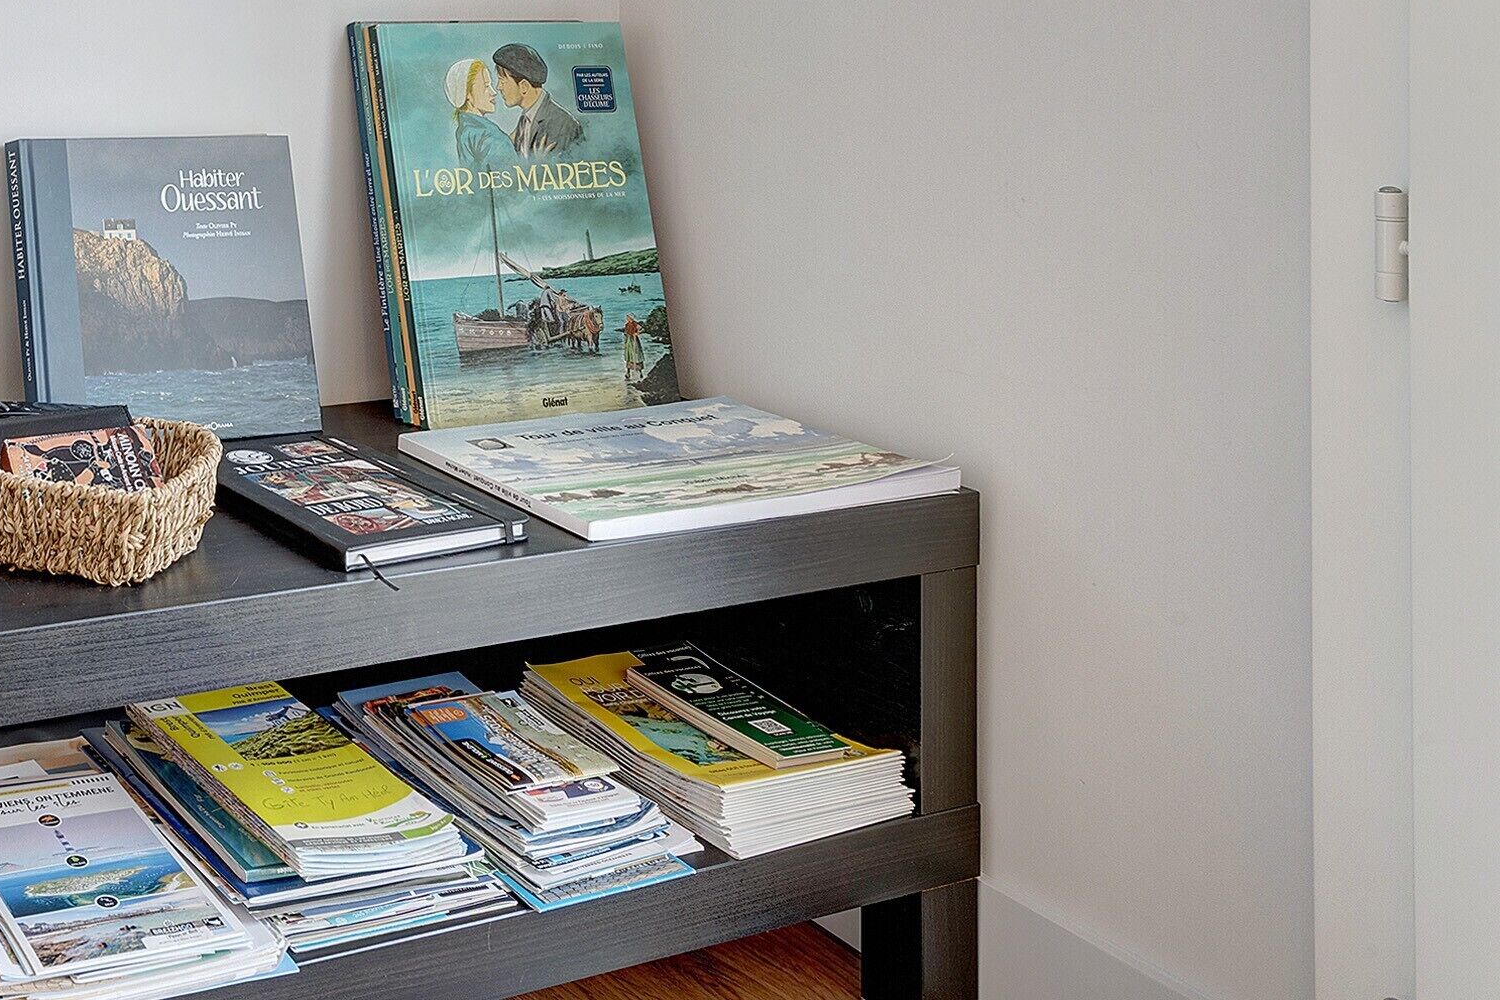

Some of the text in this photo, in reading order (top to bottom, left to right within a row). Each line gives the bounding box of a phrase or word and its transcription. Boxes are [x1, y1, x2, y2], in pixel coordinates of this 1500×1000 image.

[578, 93, 613, 101] CHASSEURS
[178, 168, 246, 189] Habiter
[412, 159, 627, 198] L'OR DES MARÉES
[160, 183, 264, 213] Ouessant
[8, 151, 25, 280] HABITER OUESSANT
[542, 396, 569, 409] Glénat
[516, 432, 558, 441] Tour
[562, 428, 585, 437] de
[585, 424, 620, 433] ville
[647, 413, 720, 427] Conquet
[117, 432, 143, 478] MINOAN
[305, 496, 385, 516] DE BORD
[245, 683, 276, 691] Brest
[568, 675, 600, 686] OUI
[232, 689, 279, 699] Quimper
[595, 690, 629, 703] VOIR
[143, 701, 182, 714] IGN
[35, 794, 54, 803] ON
